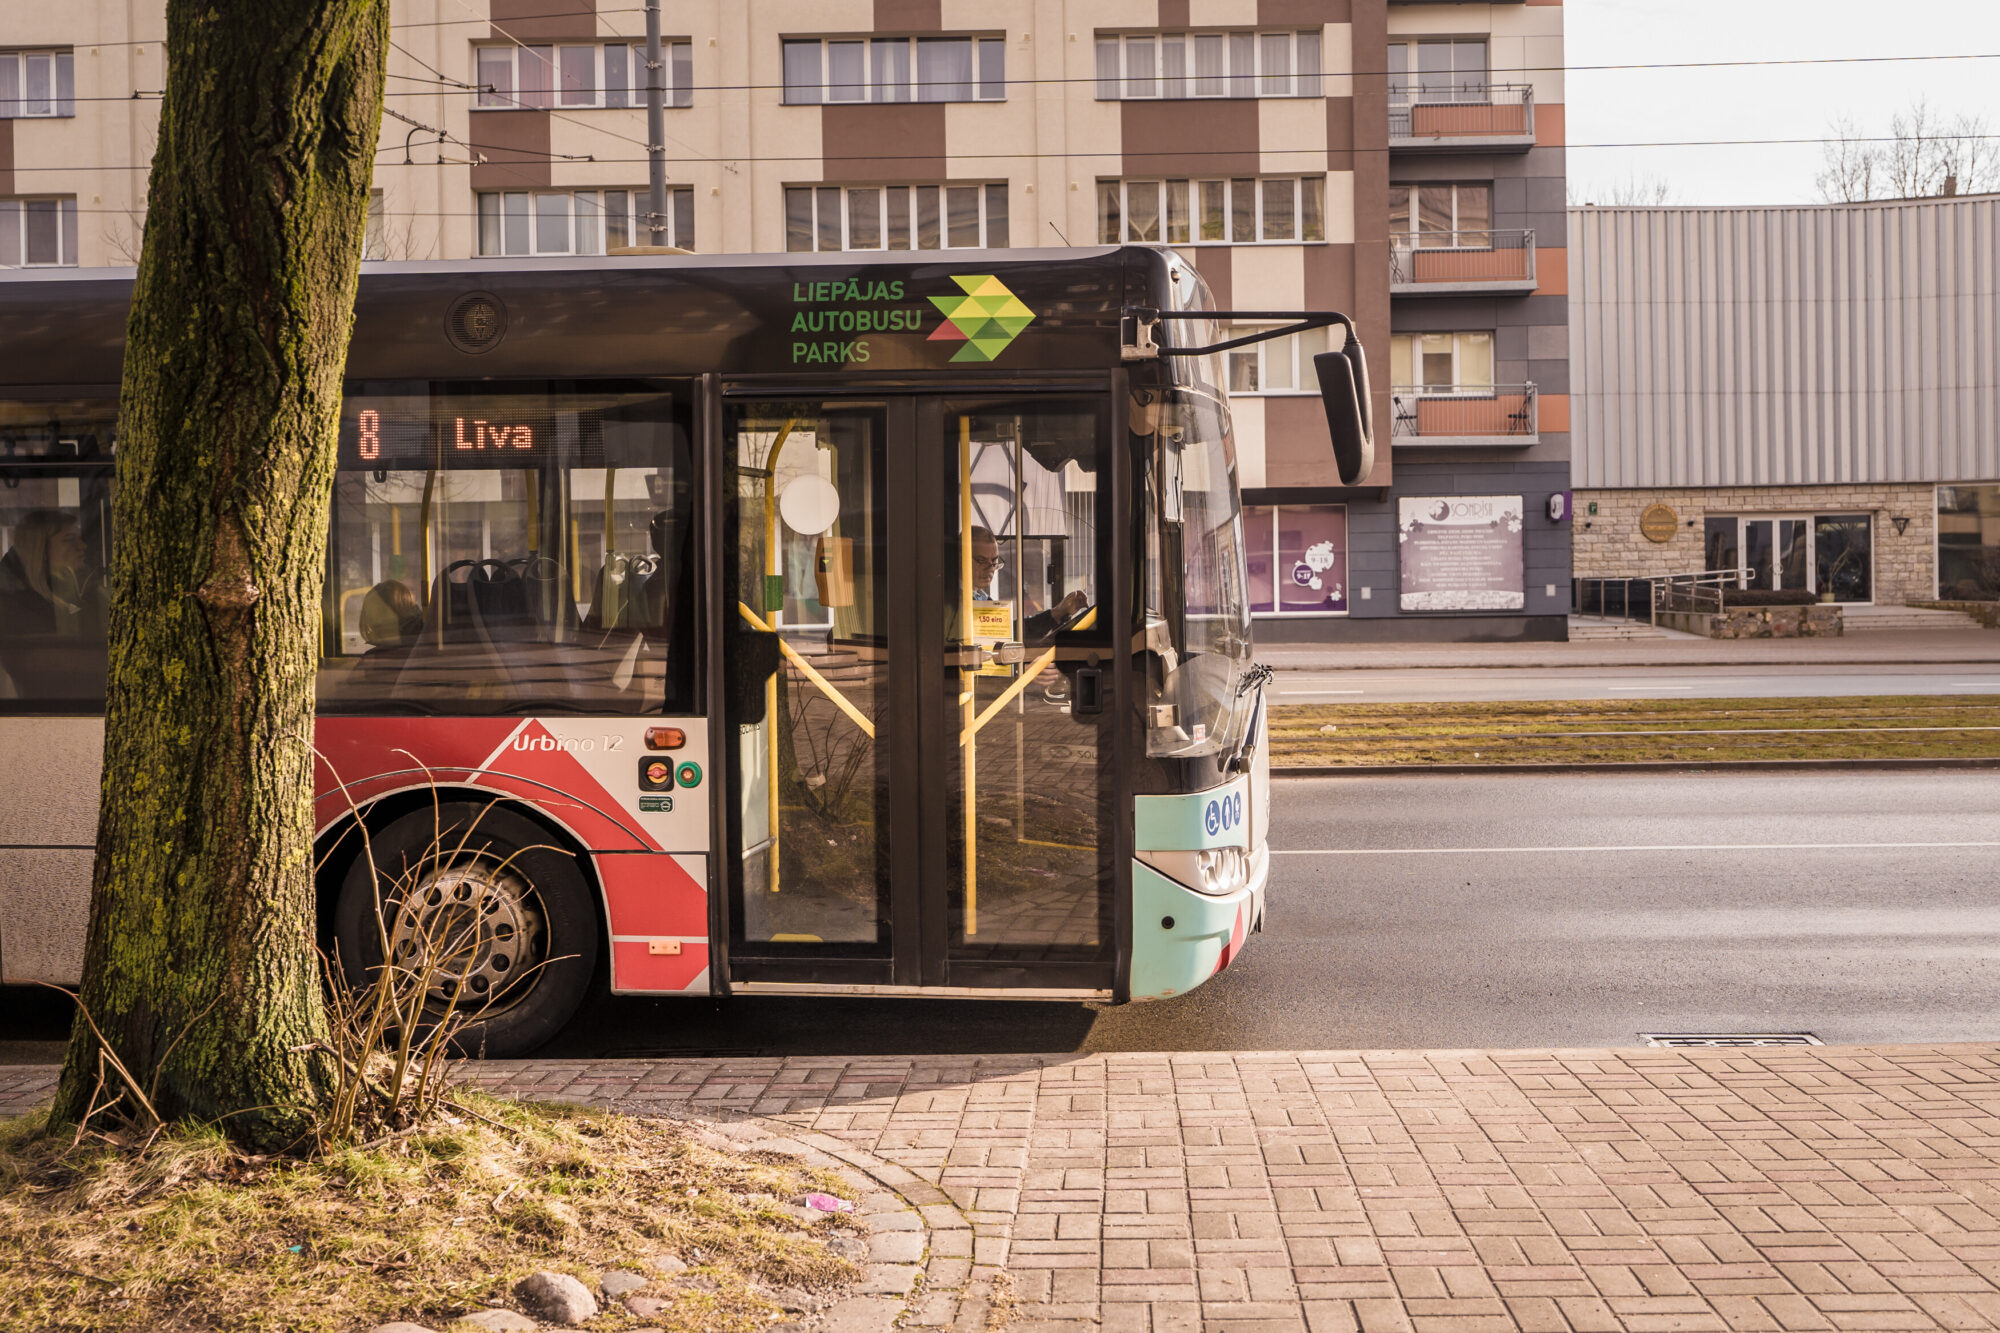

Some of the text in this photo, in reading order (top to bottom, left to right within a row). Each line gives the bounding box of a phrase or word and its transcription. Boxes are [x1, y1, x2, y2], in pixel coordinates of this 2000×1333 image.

[793, 277, 905, 303] LIEPĀJAS
[790, 309, 922, 334] AUTOBUSU
[792, 341, 871, 364] PARKS
[359, 409, 533, 460] 8 Līva
[513, 733, 625, 752] Urbino 12
